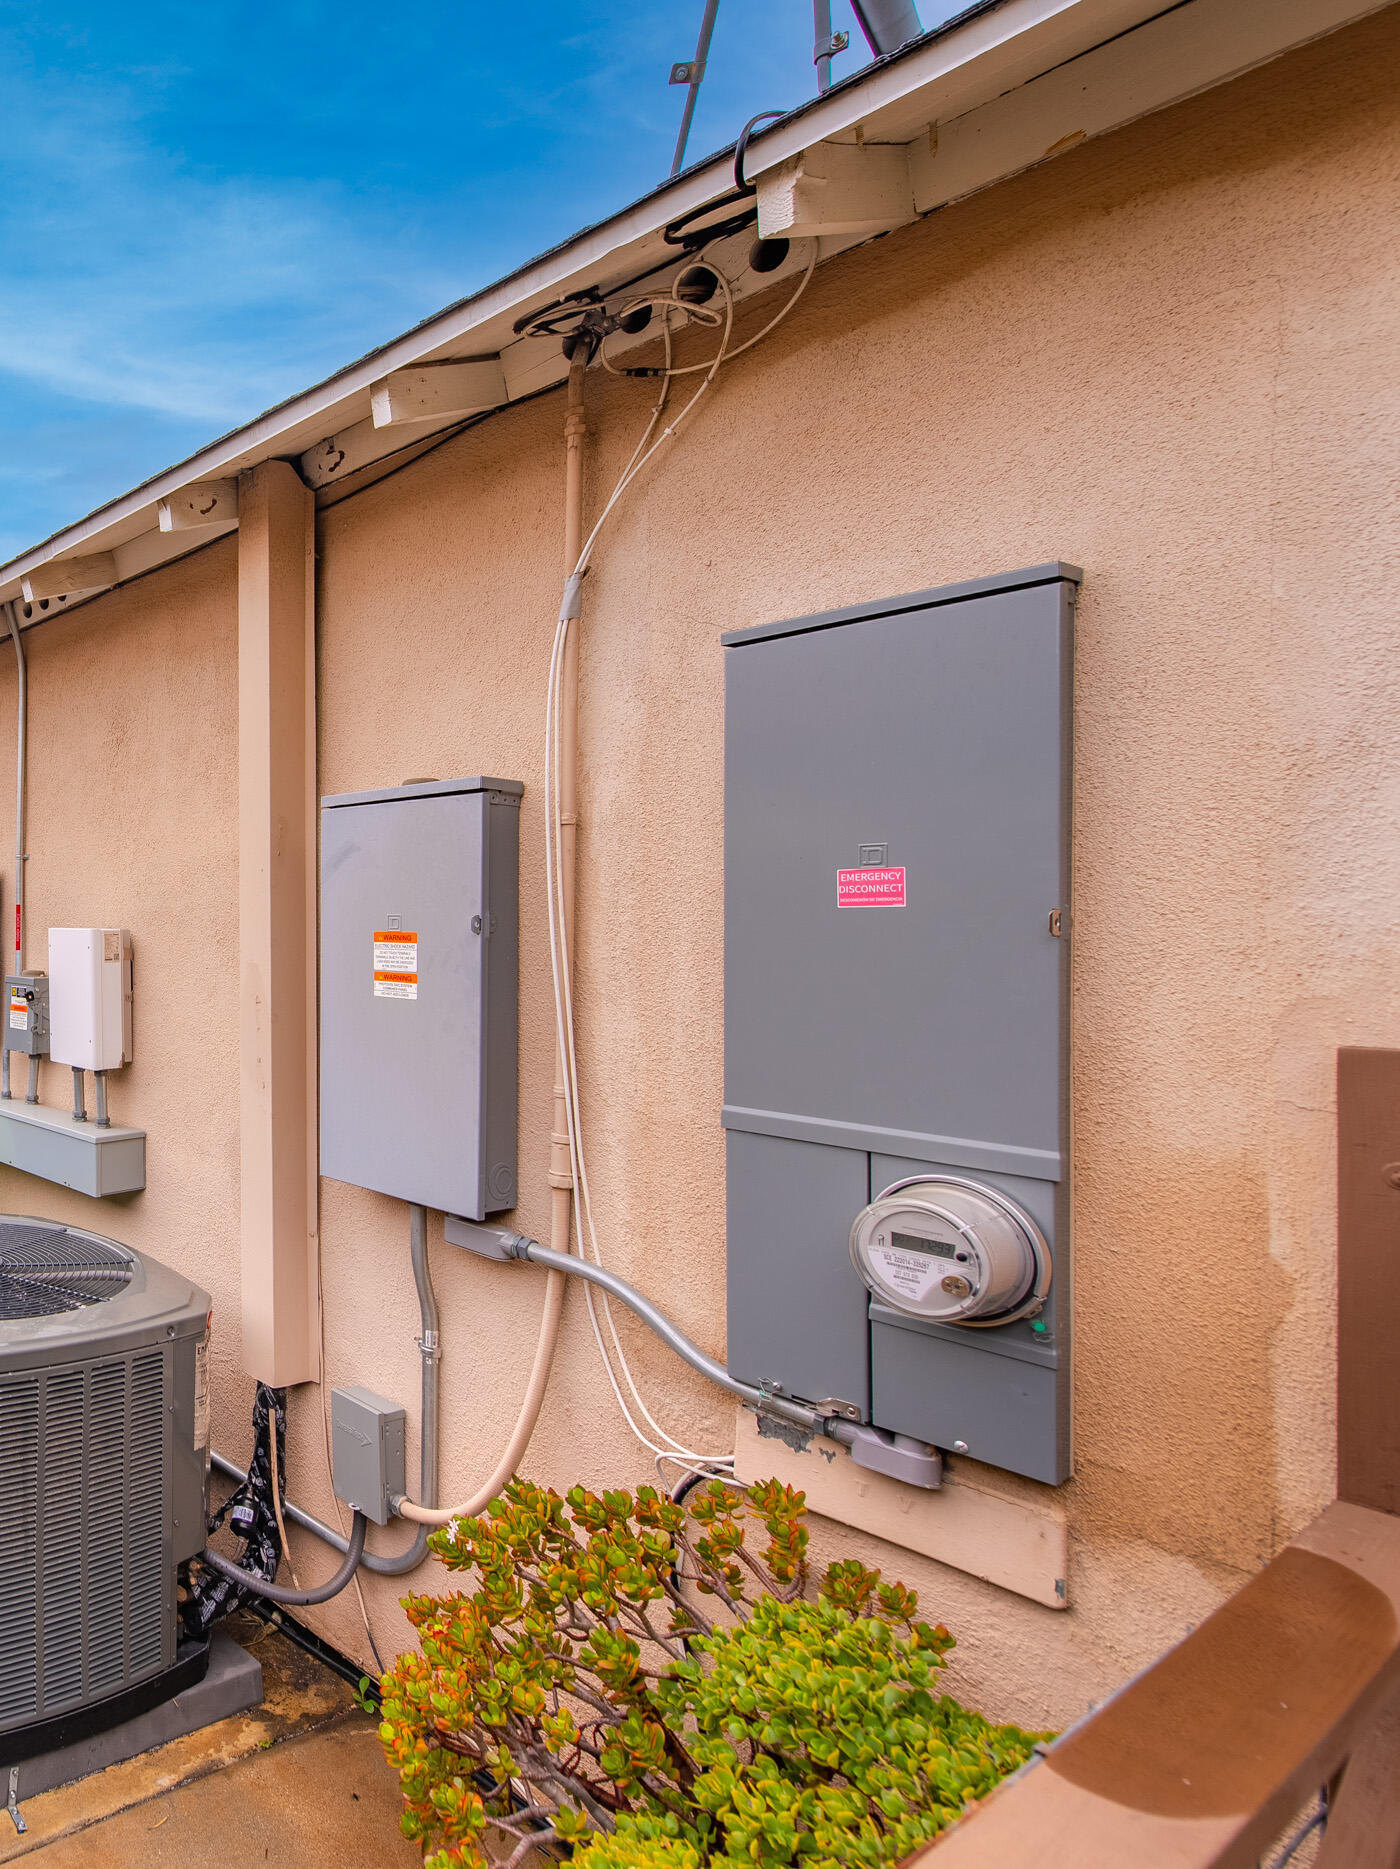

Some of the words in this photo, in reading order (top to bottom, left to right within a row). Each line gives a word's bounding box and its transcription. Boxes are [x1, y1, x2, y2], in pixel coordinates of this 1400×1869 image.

[840, 872, 901, 882] EMERGENCY
[839, 884, 903, 894] DISCONNECT
[383, 934, 412, 942] WARNING
[383, 974, 413, 982] WARNING
